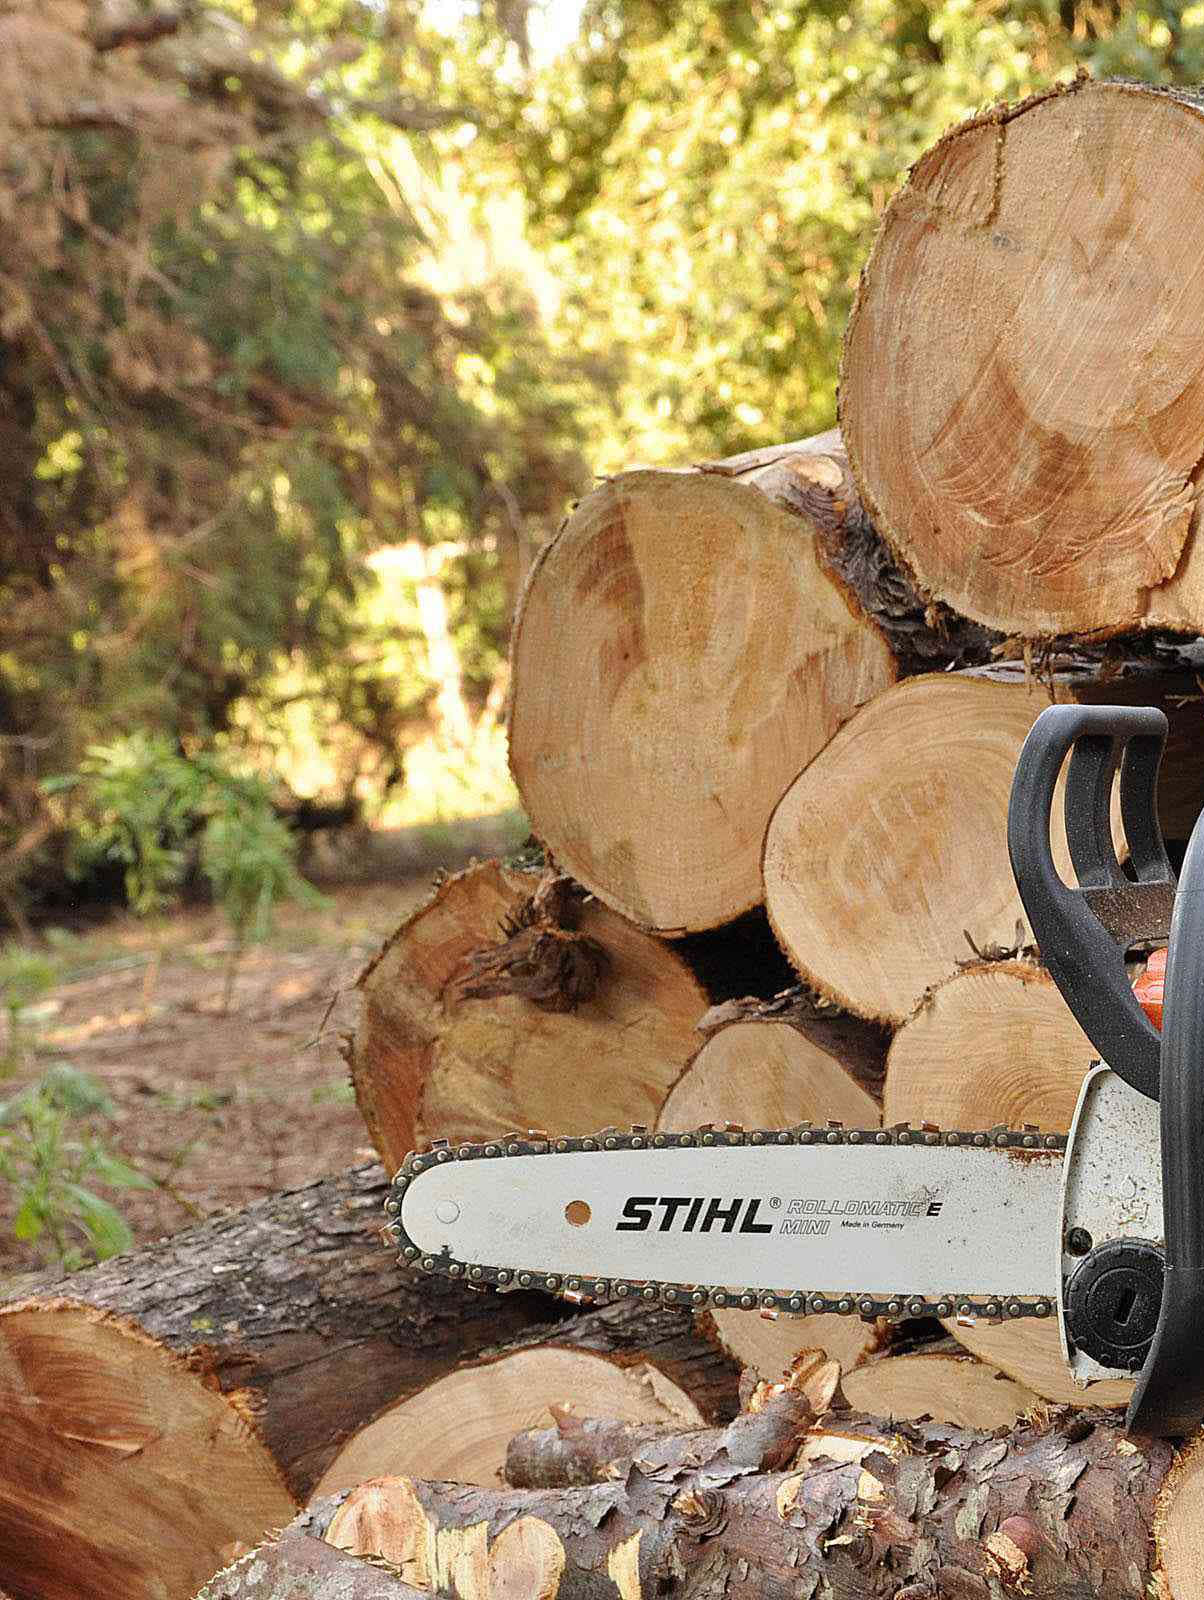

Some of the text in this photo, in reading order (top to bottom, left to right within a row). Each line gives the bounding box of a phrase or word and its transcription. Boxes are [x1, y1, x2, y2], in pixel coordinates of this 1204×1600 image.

[787, 1199, 944, 1217] ROLLOMATIC E
[779, 1219, 831, 1235] MINI
[840, 1220, 862, 1229] Made
[871, 1220, 905, 1231] Germany
